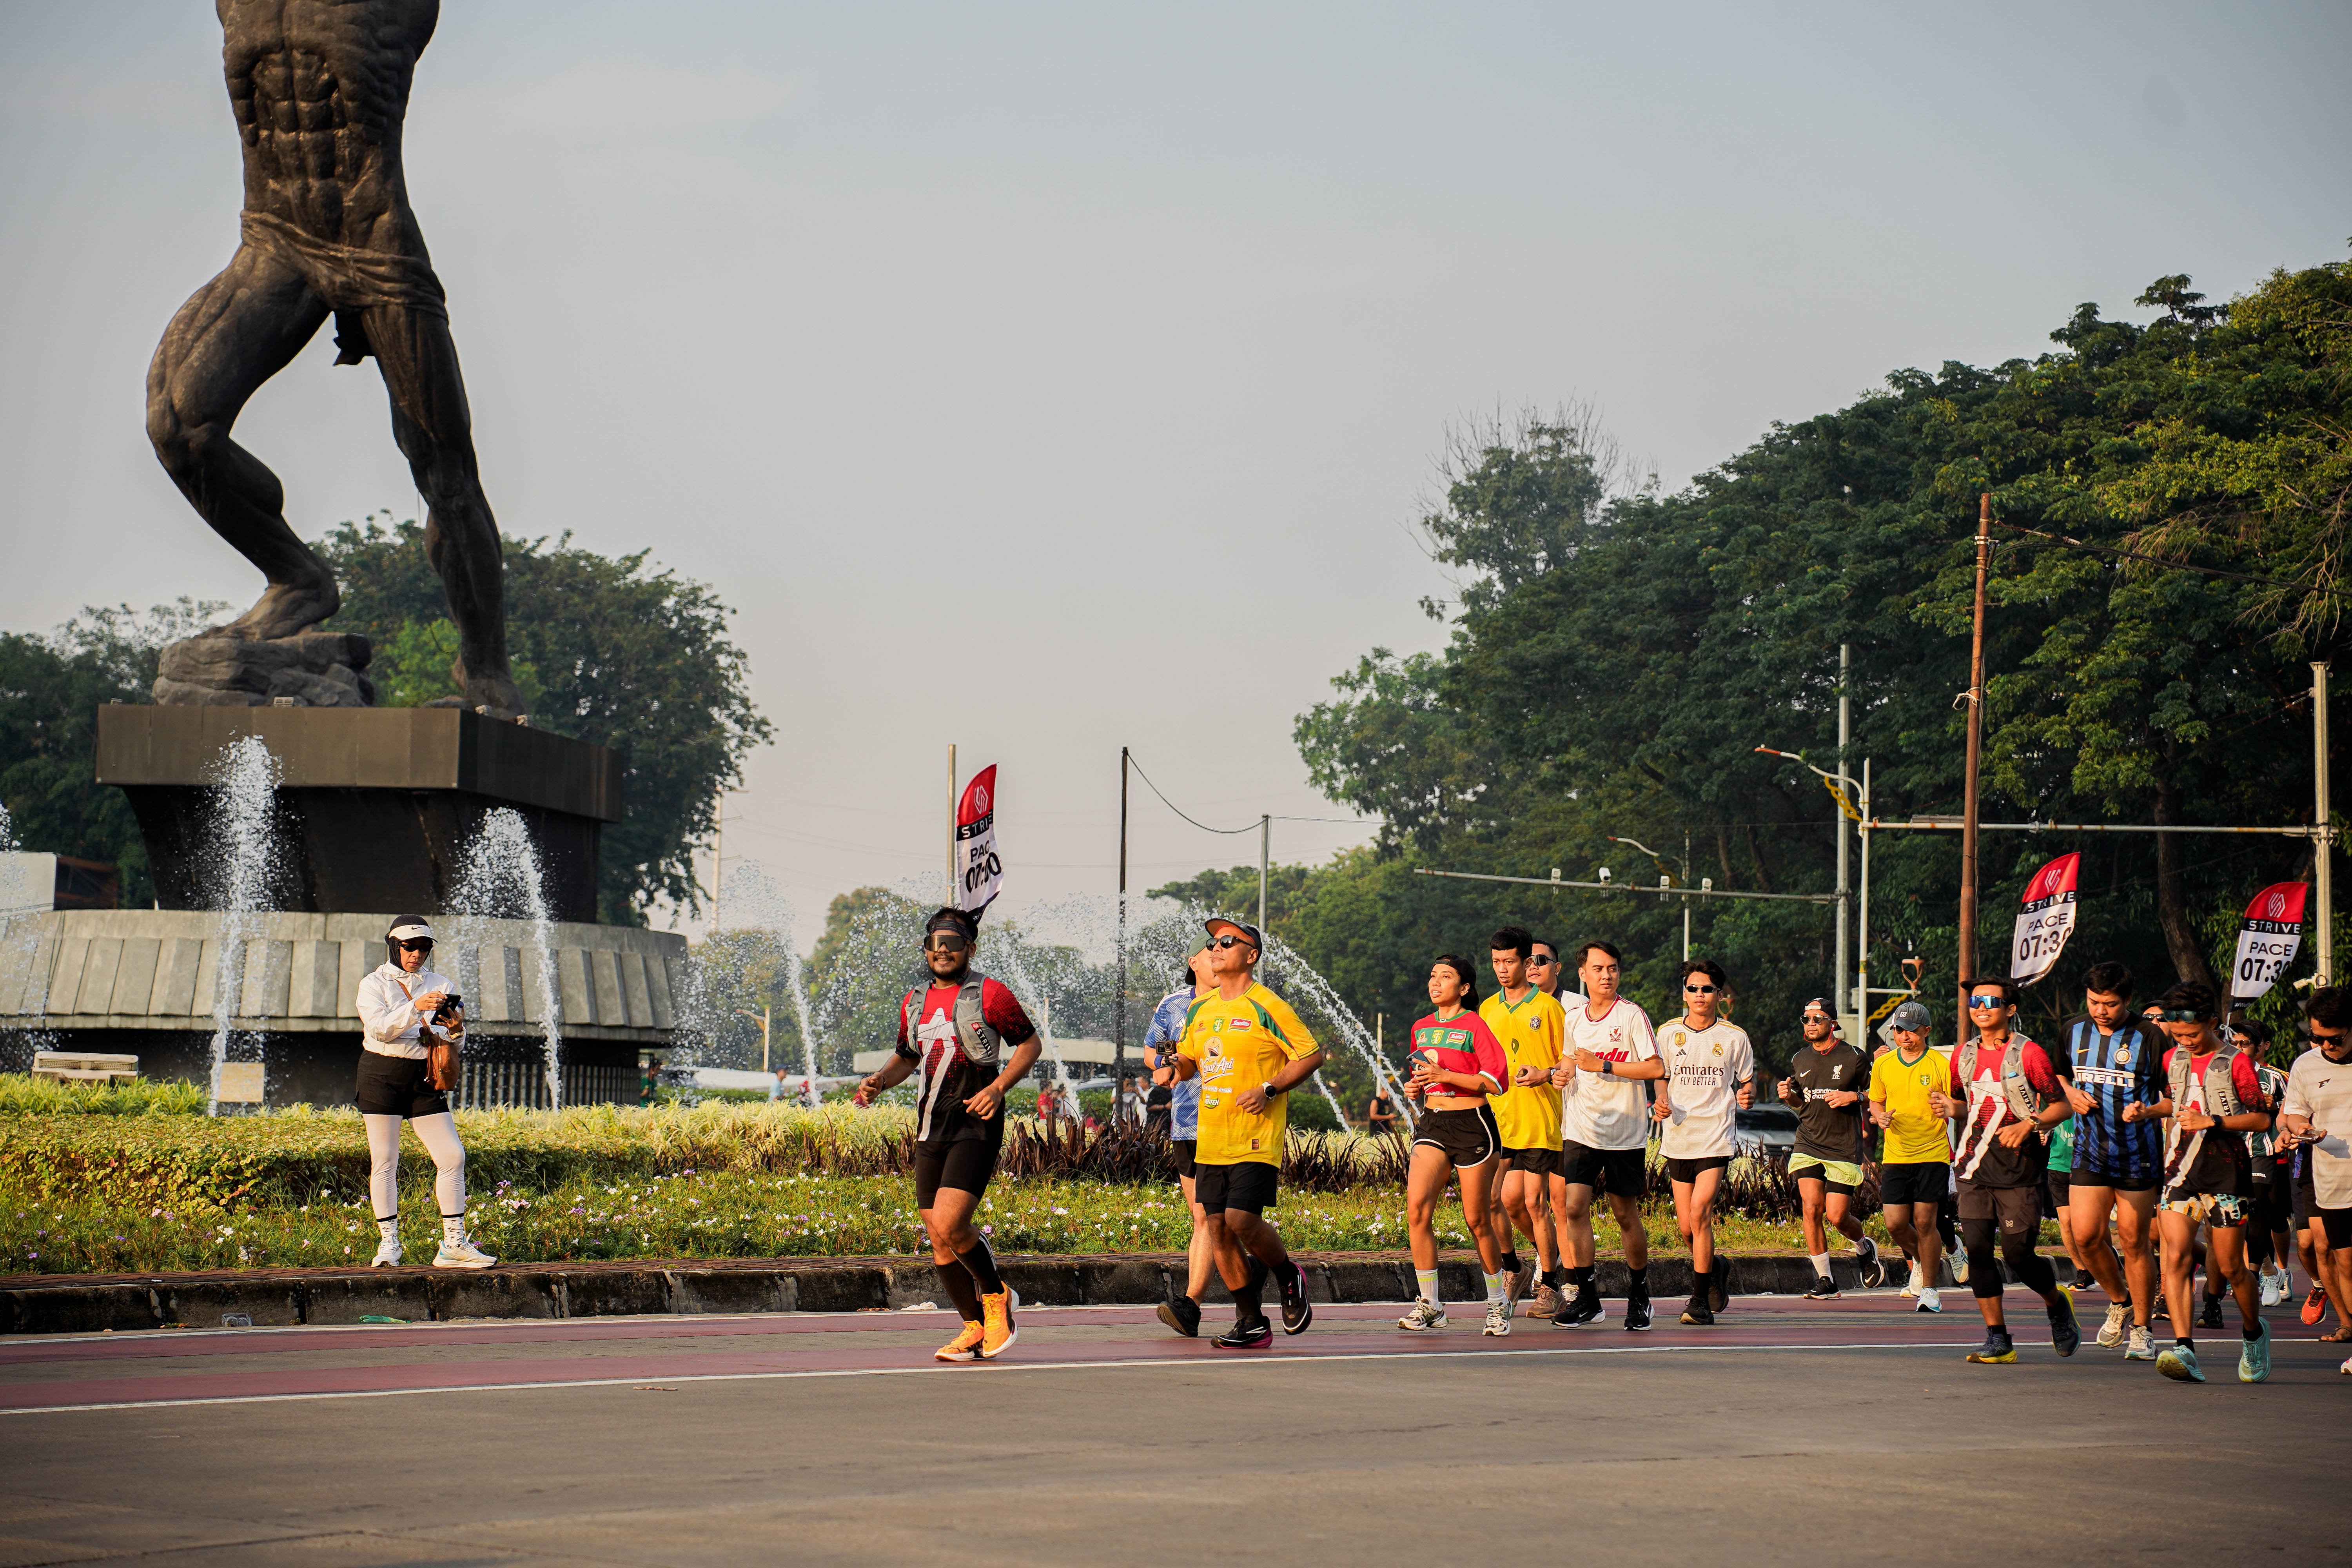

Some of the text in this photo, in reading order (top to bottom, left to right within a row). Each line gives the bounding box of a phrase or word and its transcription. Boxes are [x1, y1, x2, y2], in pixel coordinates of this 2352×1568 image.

[970, 840, 990, 863] PAC
[2027, 892, 2075, 912] STRIVE
[2026, 913, 2068, 933] PACE
[2249, 920, 2301, 934] STRIVE
[2249, 941, 2294, 956] PACE
[1216, 1056, 1234, 1074] Api
[1674, 1064, 1724, 1076] Emirates
[1681, 1076, 1716, 1085] FLY BETTER
[2072, 1065, 2135, 1088] PIRELLI
[2019, 1086, 2035, 1112] STRIVE
[2219, 1093, 2231, 1116] TRIVE
